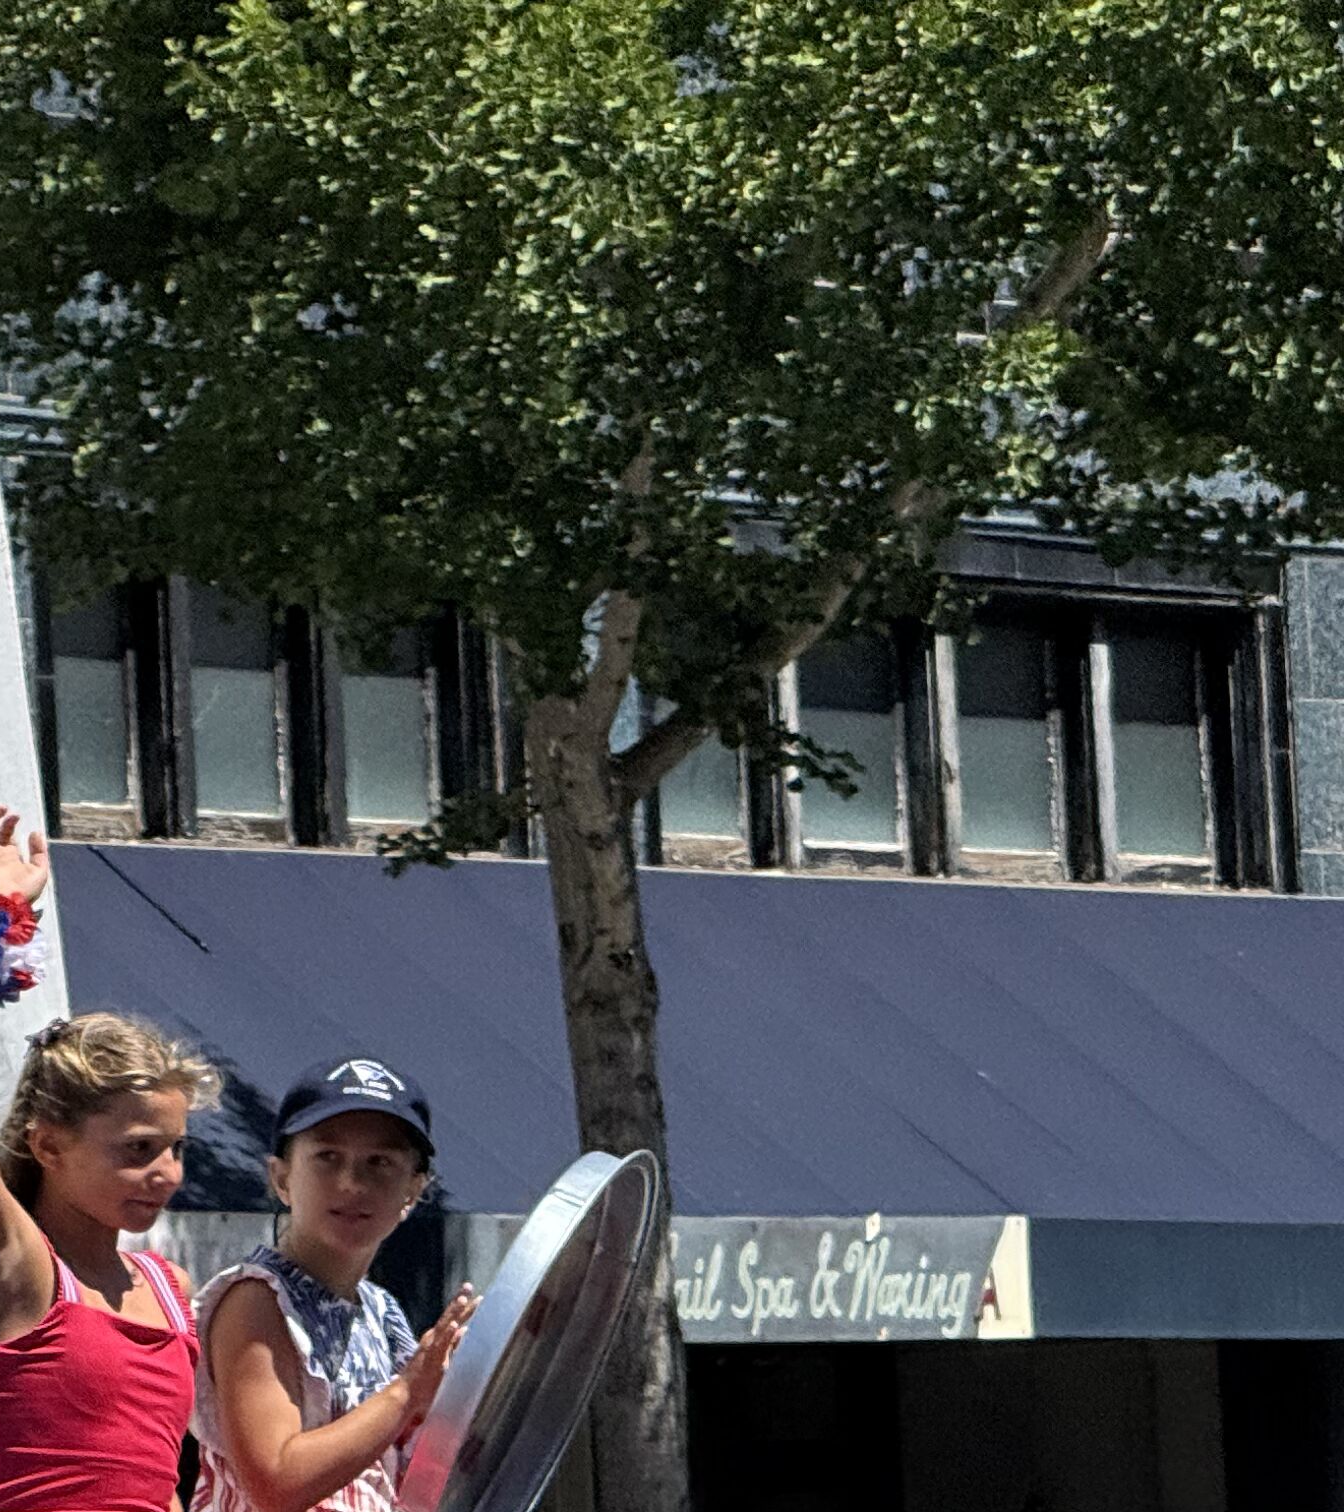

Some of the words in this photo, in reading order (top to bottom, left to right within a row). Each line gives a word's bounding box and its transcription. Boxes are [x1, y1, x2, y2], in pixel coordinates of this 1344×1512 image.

[669, 1231, 723, 1321] ail
[730, 1238, 800, 1337] Spa
[809, 1231, 844, 1319] &
[843, 1234, 973, 1339] Waxing
